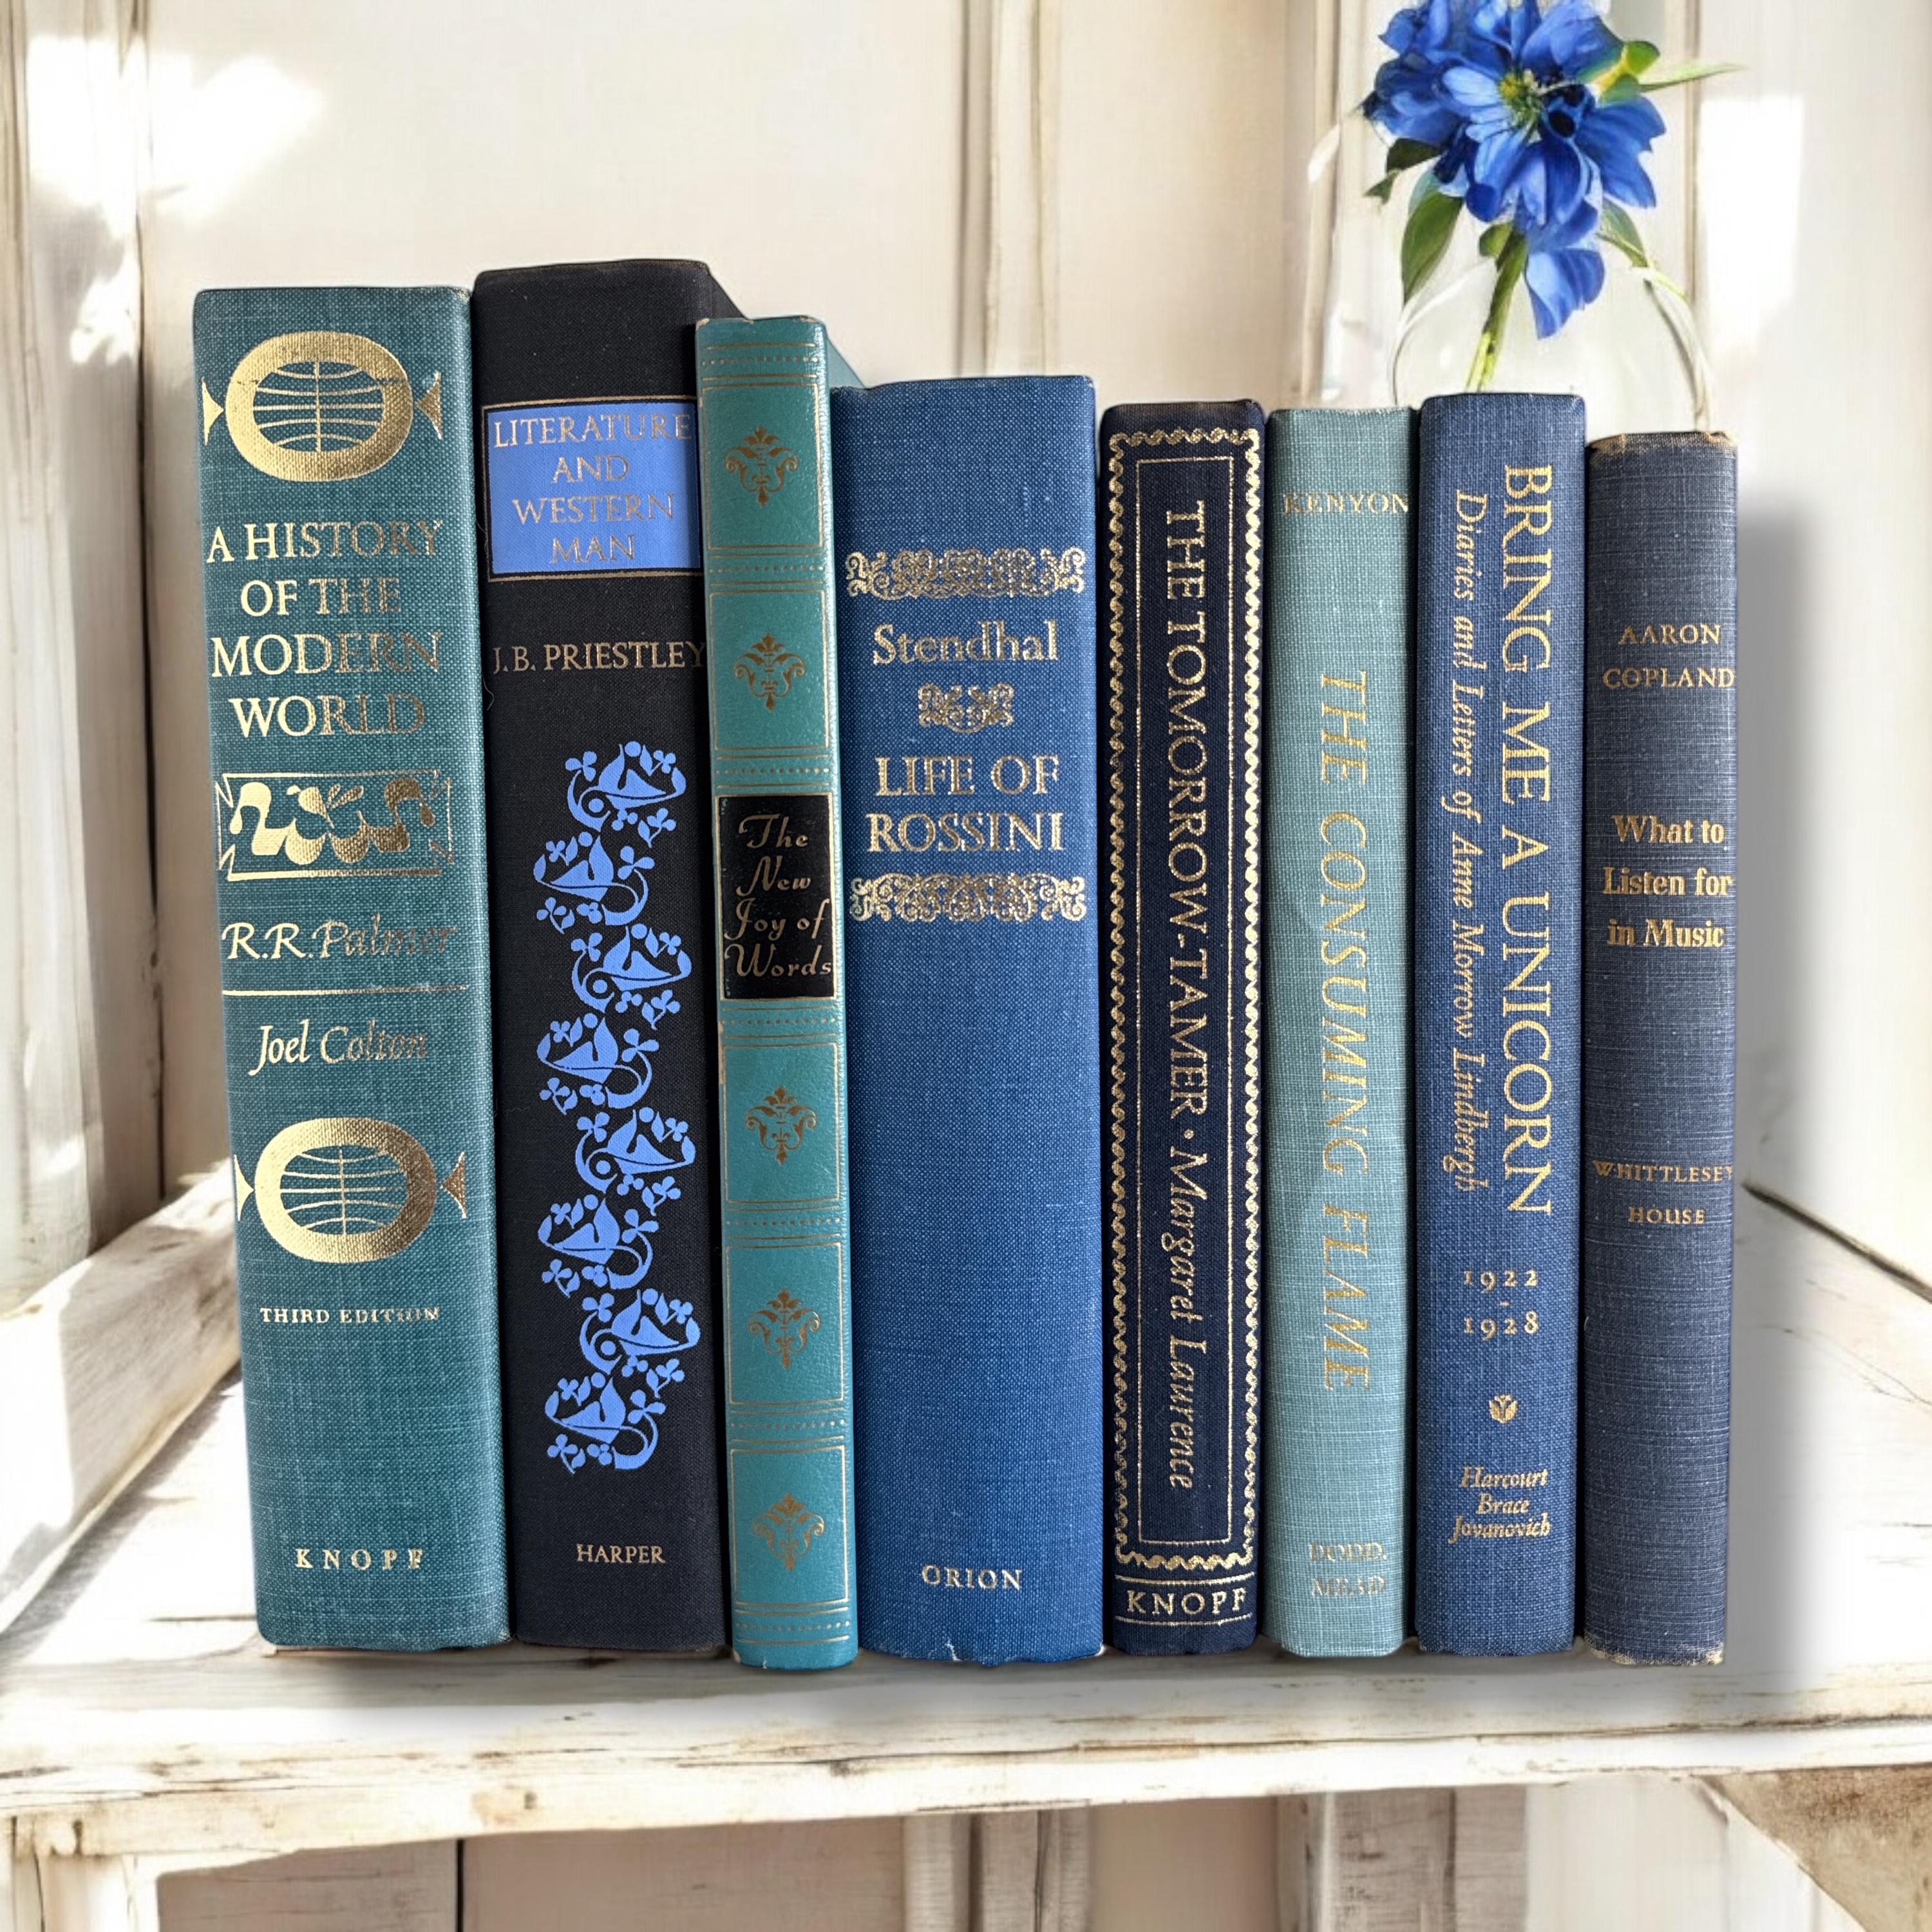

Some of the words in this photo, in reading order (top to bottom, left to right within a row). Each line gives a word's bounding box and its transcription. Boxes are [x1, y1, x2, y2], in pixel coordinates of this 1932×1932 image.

[494, 413, 692, 448] LITERATURE
[551, 453, 630, 483] AND
[512, 493, 674, 525] WESTERN
[1282, 491, 1409, 515] KENYON
[207, 527, 234, 564] A
[244, 519, 444, 559] HISTORY
[550, 534, 635, 564] MAN
[1166, 500, 1206, 600] THE
[1454, 489, 1488, 601] Diaries
[1502, 464, 1552, 673] BRING
[240, 579, 297, 616] OF
[309, 576, 402, 614] THE
[211, 631, 444, 677] MODERN
[873, 618, 1059, 666] Stendhal
[1453, 615, 1487, 671] and
[1618, 623, 1722, 646] AARON
[493, 646, 536, 675] J.B.
[544, 641, 704, 671] PRIESTLEY
[1602, 667, 1736, 689] COPLAND
[229, 692, 426, 738] WORLD
[1321, 670, 1368, 785] THE
[1452, 679, 1484, 776] Letters
[1502, 701, 1551, 804] ME
[875, 755, 976, 796] LIFE
[990, 754, 1060, 795] OF
[1441, 790, 1481, 824] of
[739, 813, 810, 849] The
[866, 811, 1066, 853] ROSSINI
[1502, 825, 1549, 869] A
[1611, 814, 1694, 844] What
[1700, 819, 1725, 844] to
[736, 855, 812, 897] New
[1166, 609, 1209, 1119] TOMORROW-TAMER
[1452, 831, 1483, 909] Anne
[1602, 866, 1685, 895] Listen
[1695, 866, 1733, 896] for
[222, 922, 315, 960] R.R.
[311, 912, 459, 960] Palmer
[723, 897, 787, 941] Joy
[796, 898, 831, 940] of
[1608, 919, 1634, 946] in
[1642, 918, 1725, 947] Music
[724, 943, 833, 978] Words
[1452, 919, 1484, 1039] Morrow
[1320, 811, 1370, 1175] CONSUMING
[247, 1018, 311, 1077] Joel
[320, 1019, 428, 1065] Colton
[1502, 891, 1553, 1216] UNICORN
[1443, 1047, 1490, 1192] Lindbergh
[1161, 1146, 1208, 1321] Margaret
[1627, 1205, 1705, 1225] HOUSE
[1322, 1202, 1370, 1391] FLAME
[1463, 1269, 1539, 1294] 1922
[260, 1307, 330, 1323] THIRD
[339, 1307, 440, 1323] EDITION
[1463, 1310, 1539, 1341] 1928
[1170, 1334, 1208, 1489] Laurence
[1459, 1465, 1548, 1488] Harcourt
[1475, 1492, 1530, 1515] Brace
[1448, 1512, 1551, 1545] Jovanovich
[295, 1548, 425, 1570] KNOPF
[576, 1542, 666, 1564] HARPER
[921, 1564, 1023, 1591] ORION
[1126, 1587, 1247, 1615] KNOPF
